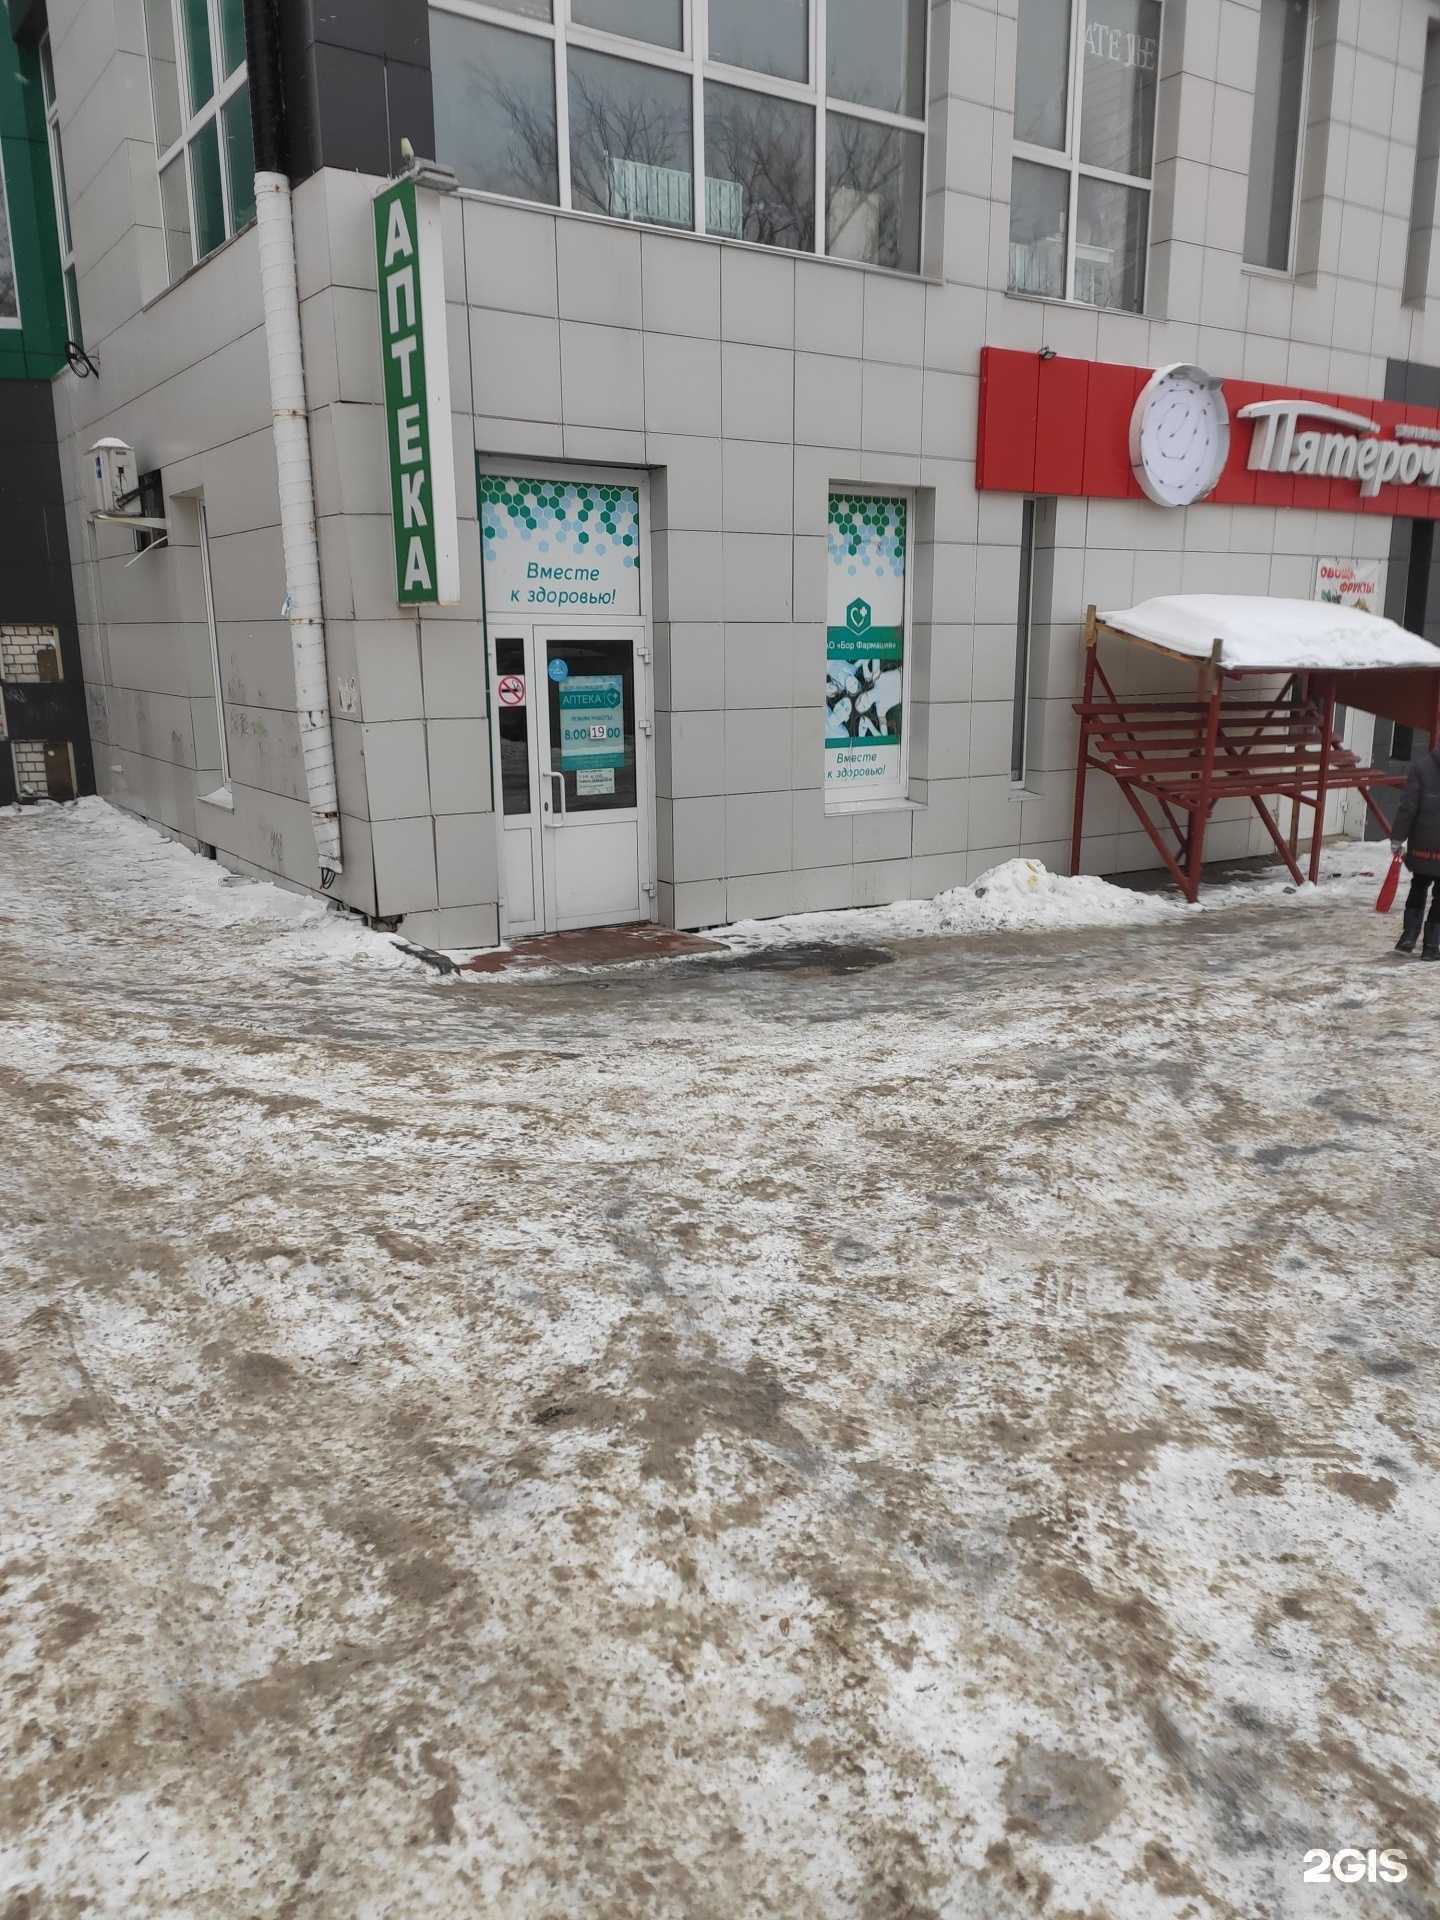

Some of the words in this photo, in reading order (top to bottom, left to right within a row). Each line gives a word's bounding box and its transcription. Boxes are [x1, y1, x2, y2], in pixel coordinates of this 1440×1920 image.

[384, 198, 432, 591] АПТЕКА
[527, 561, 600, 581] Вместе
[510, 590, 520, 602] к
[527, 587, 616, 607] здоровью!
[562, 694, 602, 705] АПТЕКА
[836, 752, 877, 764] Вместе
[836, 764, 886, 780] здоровью!
